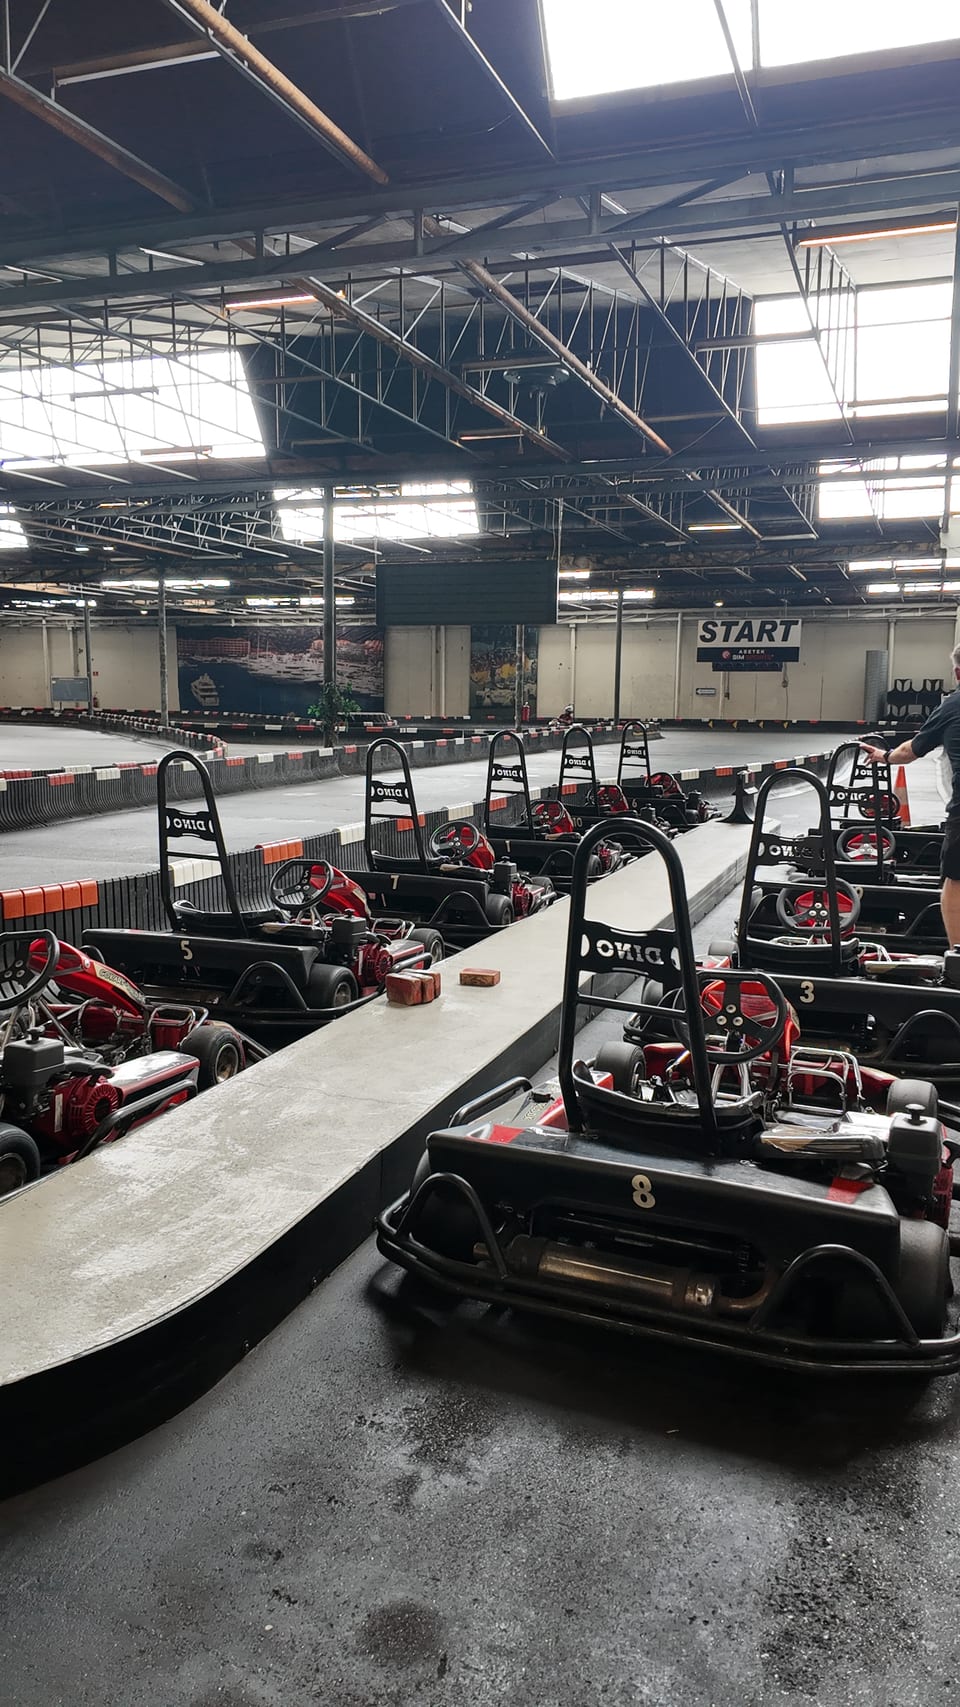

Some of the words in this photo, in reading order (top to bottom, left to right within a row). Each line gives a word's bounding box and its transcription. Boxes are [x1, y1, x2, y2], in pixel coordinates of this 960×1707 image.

[699, 620, 799, 643] START
[390, 875, 400, 890] 7
[180, 940, 193, 960] 5
[800, 980, 815, 1003] 3
[631, 1174, 656, 1209] 8
